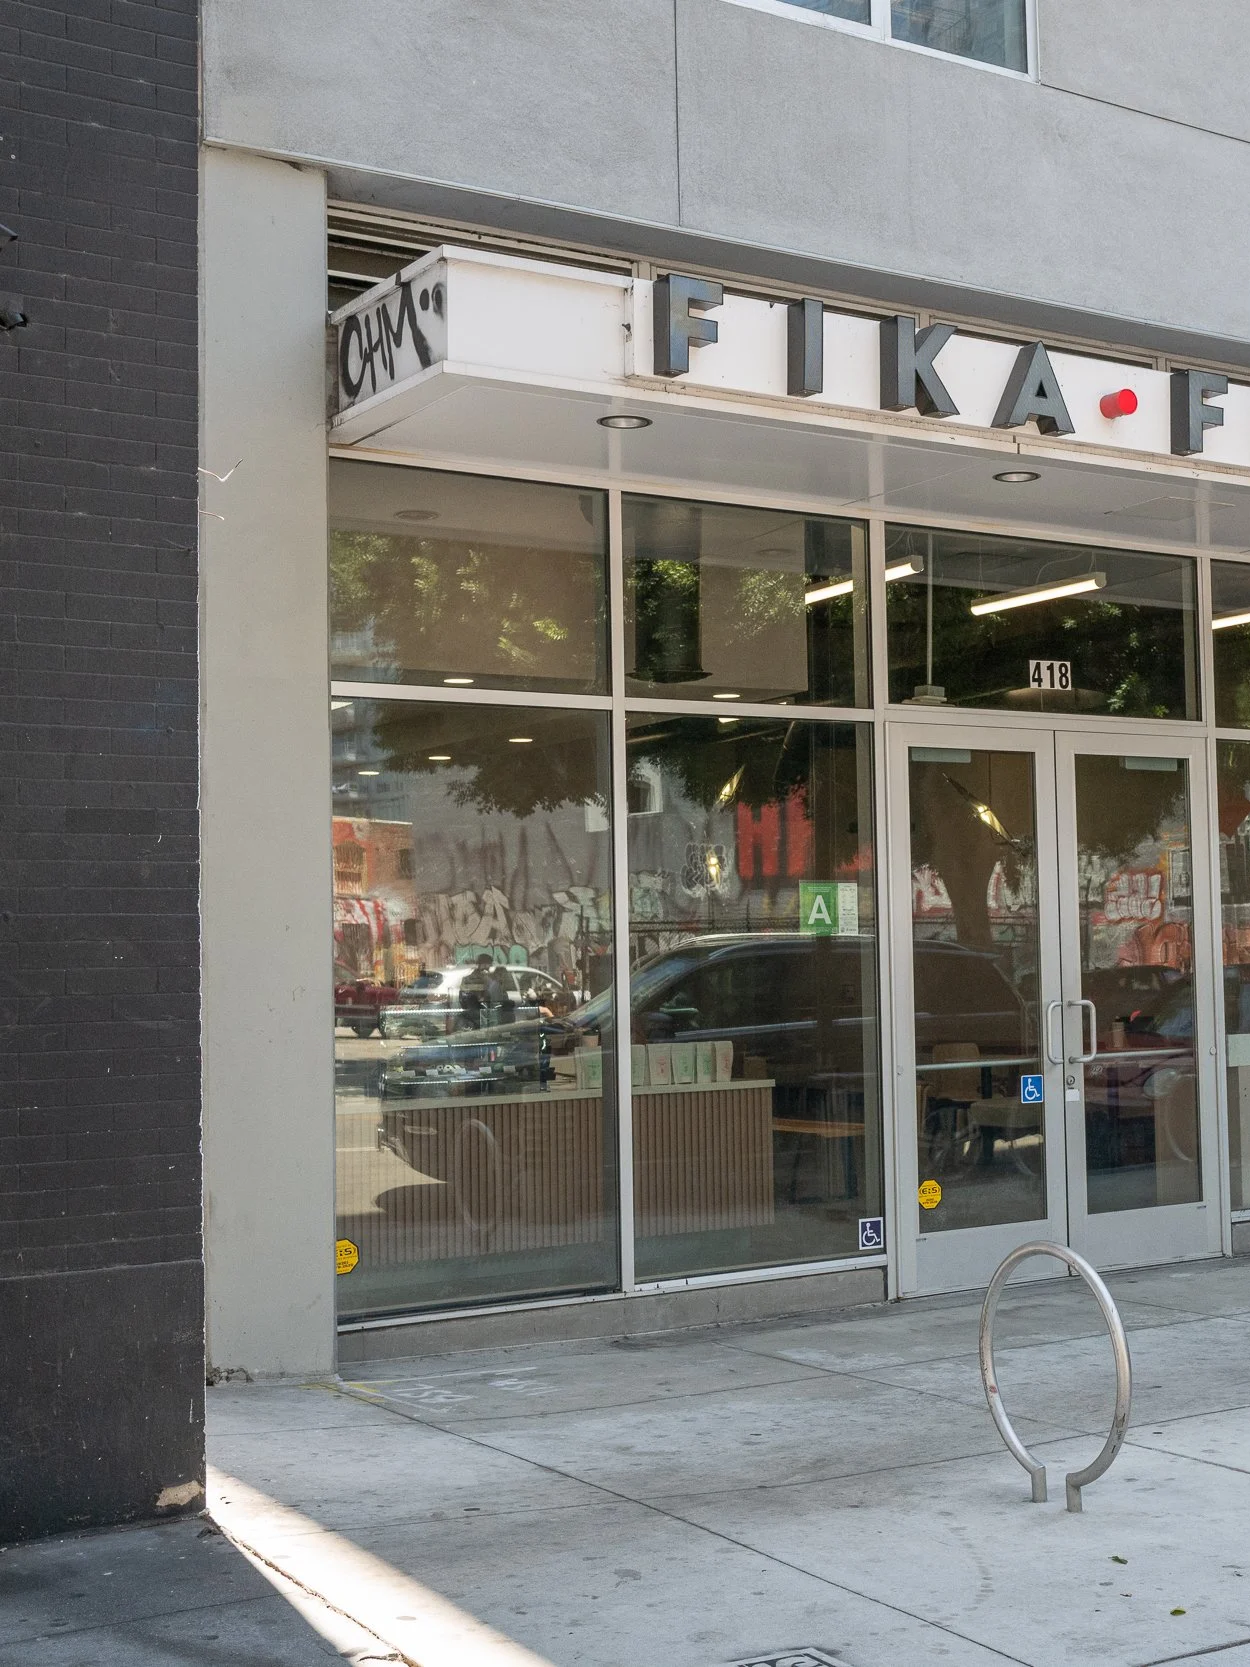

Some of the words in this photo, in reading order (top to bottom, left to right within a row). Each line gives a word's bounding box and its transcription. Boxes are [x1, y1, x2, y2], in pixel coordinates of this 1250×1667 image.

[653, 273, 1075, 436] FIKA
[1031, 661, 1070, 690] 418
[807, 894, 833, 925] A
